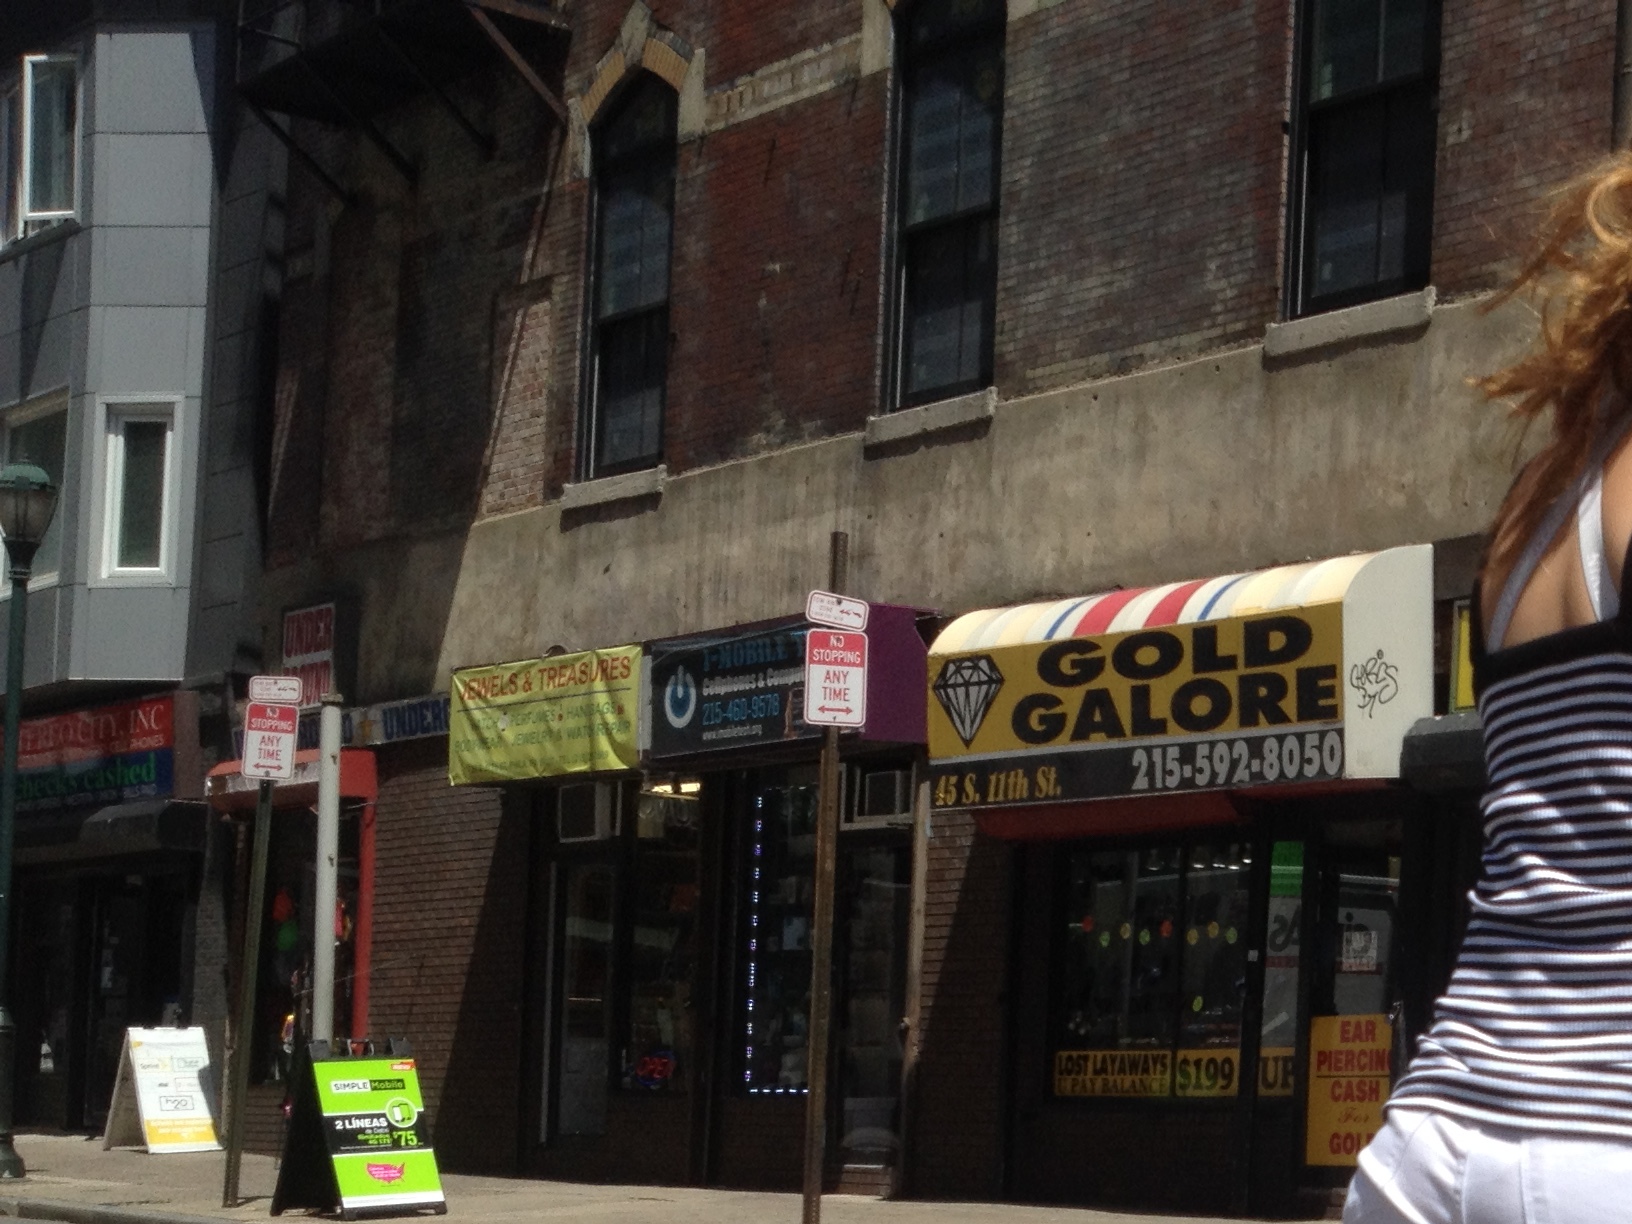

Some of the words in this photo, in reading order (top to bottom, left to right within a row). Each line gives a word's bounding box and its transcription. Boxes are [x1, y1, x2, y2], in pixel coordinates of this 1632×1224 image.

[830, 635, 845, 648] NO
[1036, 615, 1313, 688] GOLD
[813, 649, 861, 664] STOPPING
[459, 672, 519, 701] JEWELS
[522, 671, 533, 693] &
[538, 656, 632, 689] TREASURES
[824, 669, 849, 685] ANY
[822, 686, 850, 702] TIME
[1011, 663, 1339, 745] GALORE
[129, 704, 165, 735] INC
[266, 706, 280, 718] NO
[251, 718, 293, 732] STOPPING
[259, 735, 282, 748] ANY
[258, 748, 282, 761] TIME
[1132, 731, 1342, 791] 215-592-8050
[934, 775, 957, 807] 45
[962, 773, 980, 802] S.
[986, 768, 1032, 799] 11th
[1034, 766, 1062, 797] St.
[1340, 1019, 1376, 1044] EAR
[1057, 1053, 1090, 1077] LOST
[1093, 1052, 1169, 1077] LAYAWAYS
[1178, 1055, 1235, 1094] $199
[333, 1081, 369, 1091] SIMPLE
[371, 1080, 404, 1090] Mobile
[1070, 1078, 1098, 1095] PAY
[1101, 1077, 1168, 1095] BALANCE
[1329, 1079, 1381, 1103] CASH
[335, 1120, 344, 1130] 2
[345, 1116, 388, 1129] LÍNEAS
[1328, 1132, 1373, 1156] GOL
